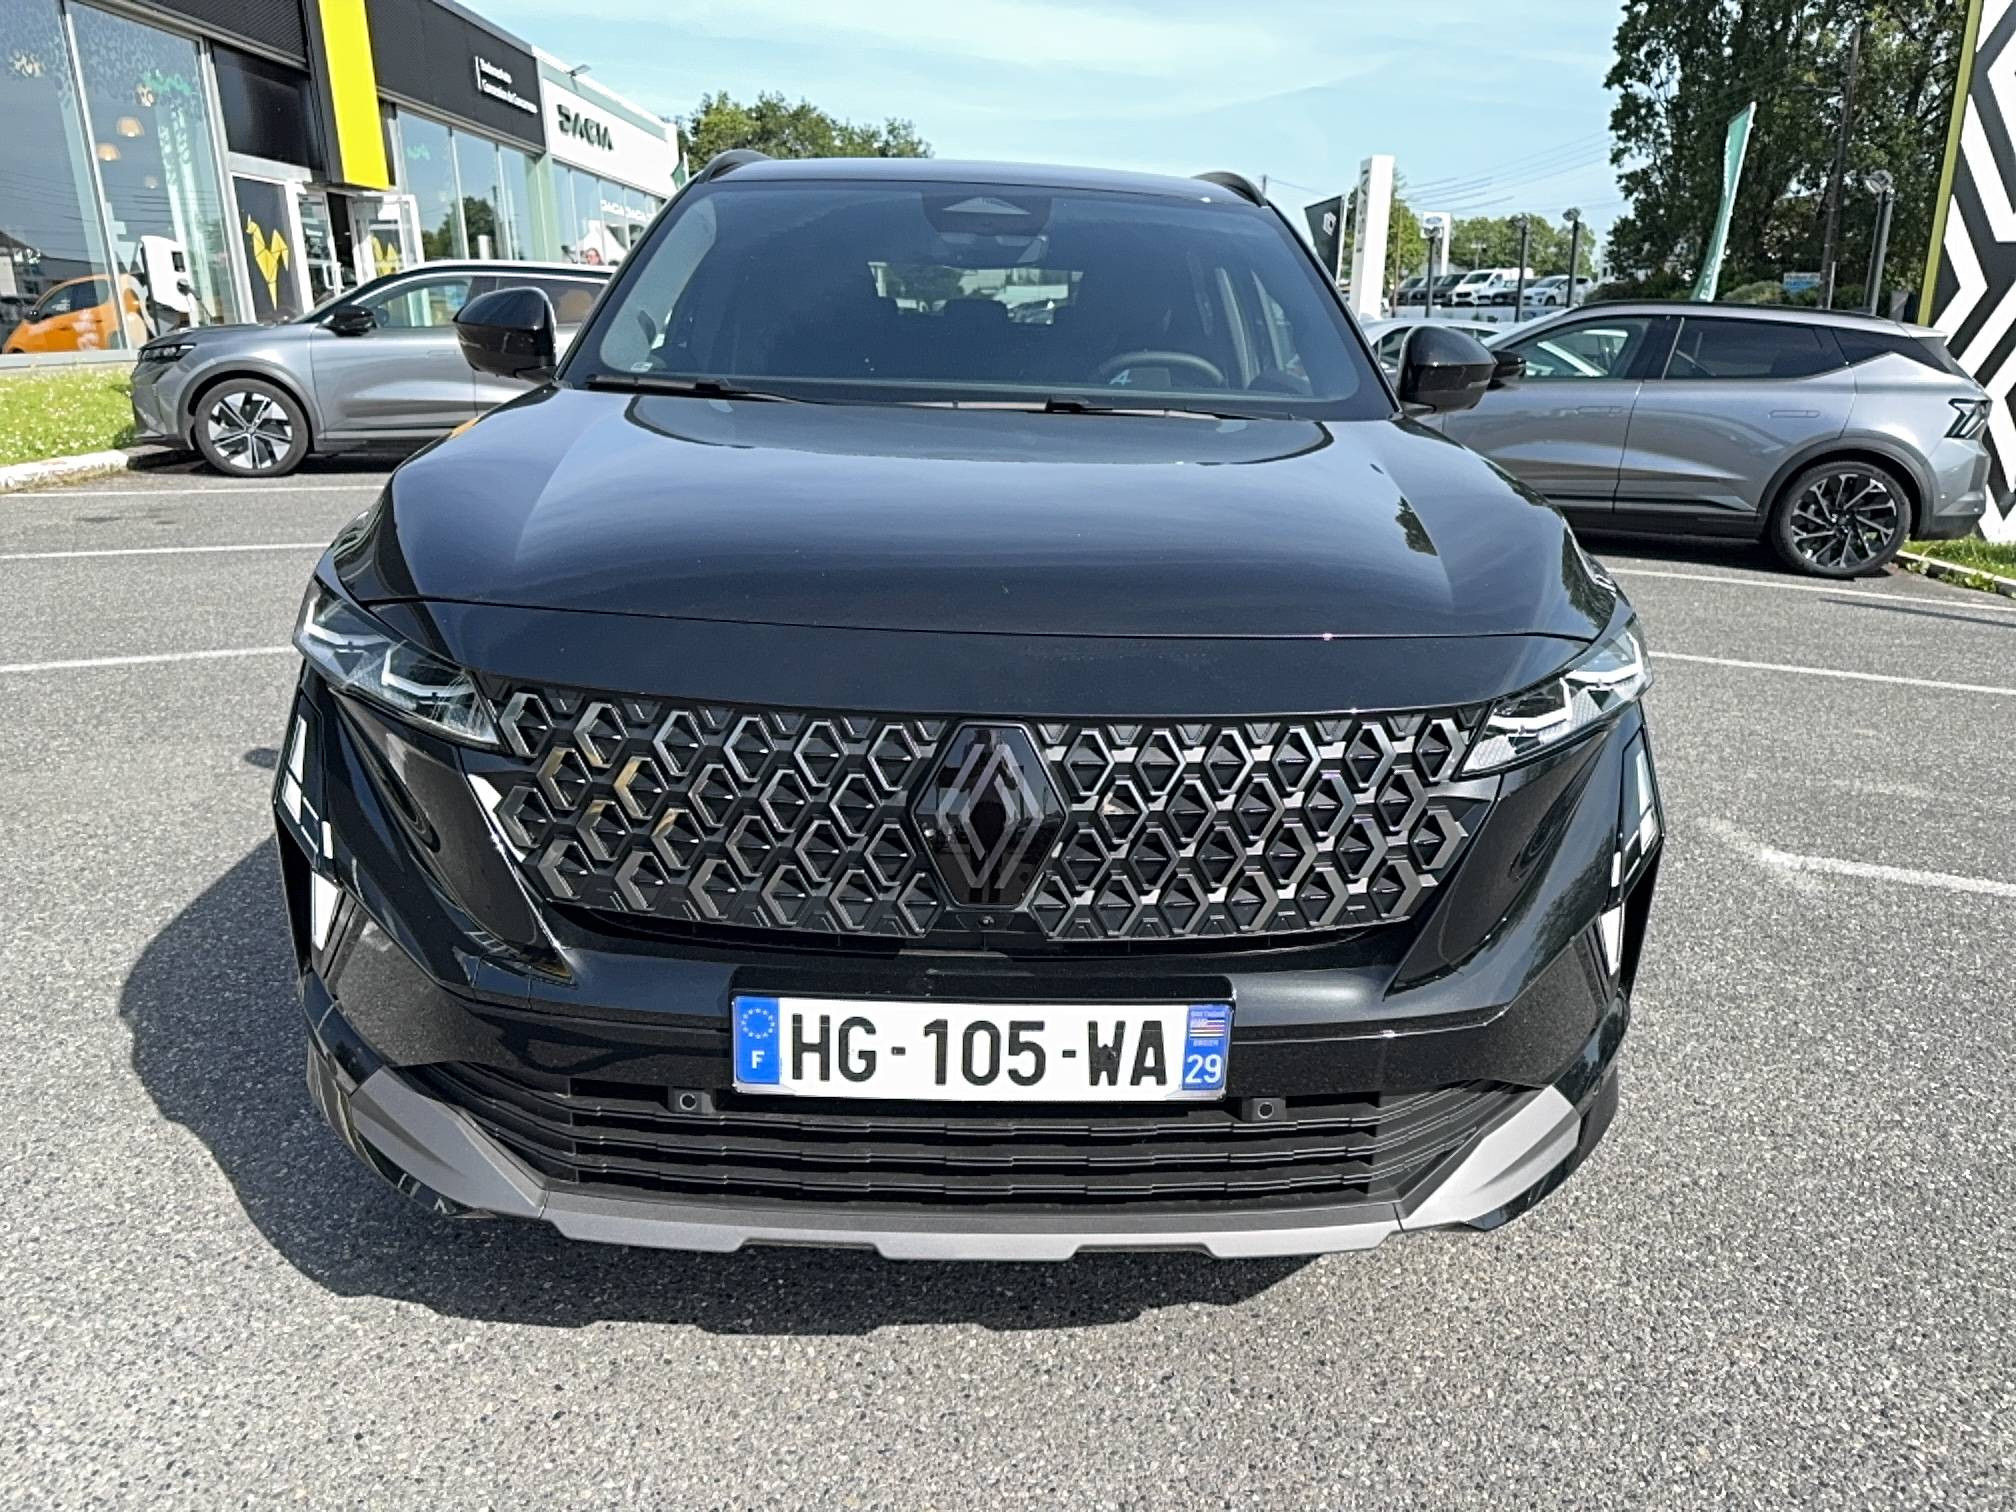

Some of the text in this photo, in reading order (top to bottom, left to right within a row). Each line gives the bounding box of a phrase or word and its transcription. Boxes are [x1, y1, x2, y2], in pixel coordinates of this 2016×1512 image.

[556, 104, 613, 151] DACIA
[751, 1050, 765, 1069] F
[791, 1014, 1168, 1087] HG-105-WA
[1185, 1053, 1221, 1083] 29
